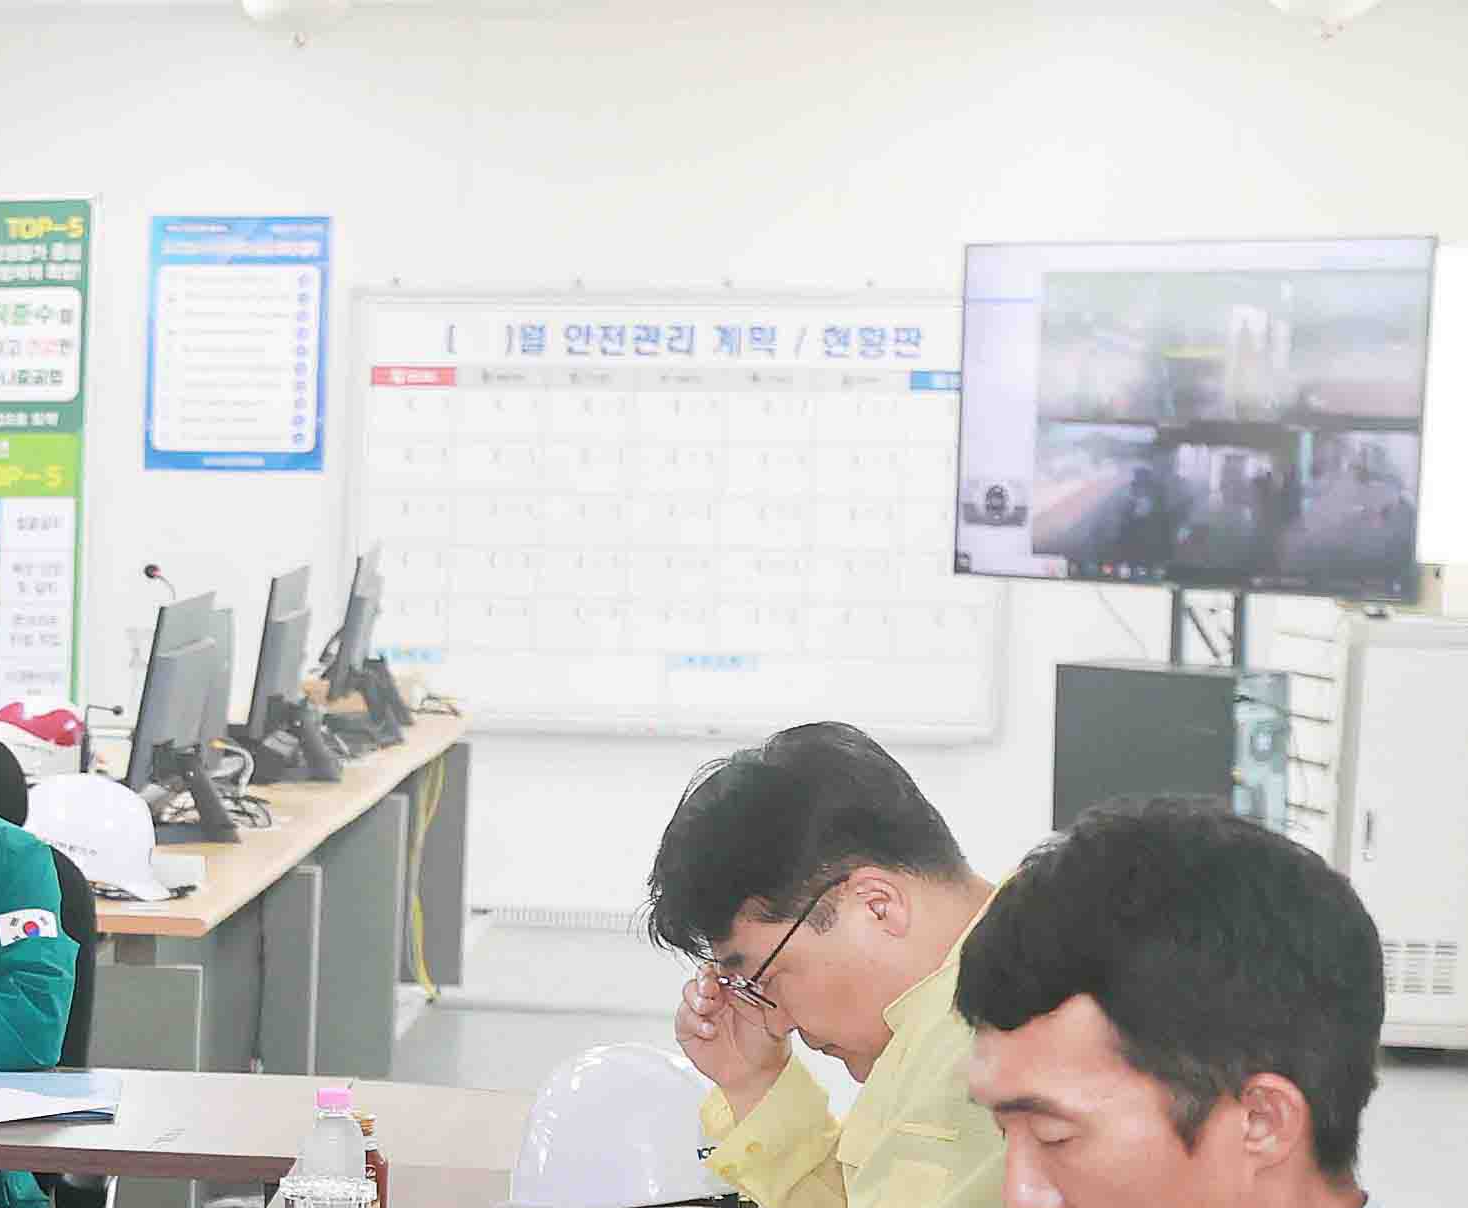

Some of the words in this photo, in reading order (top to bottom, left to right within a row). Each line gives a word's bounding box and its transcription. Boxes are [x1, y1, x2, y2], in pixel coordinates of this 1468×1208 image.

[6, 217, 85, 240] TOP-5
[564, 323, 695, 358] 안전관리
[713, 325, 777, 358] 계획
[823, 324, 922, 359] 현황판
